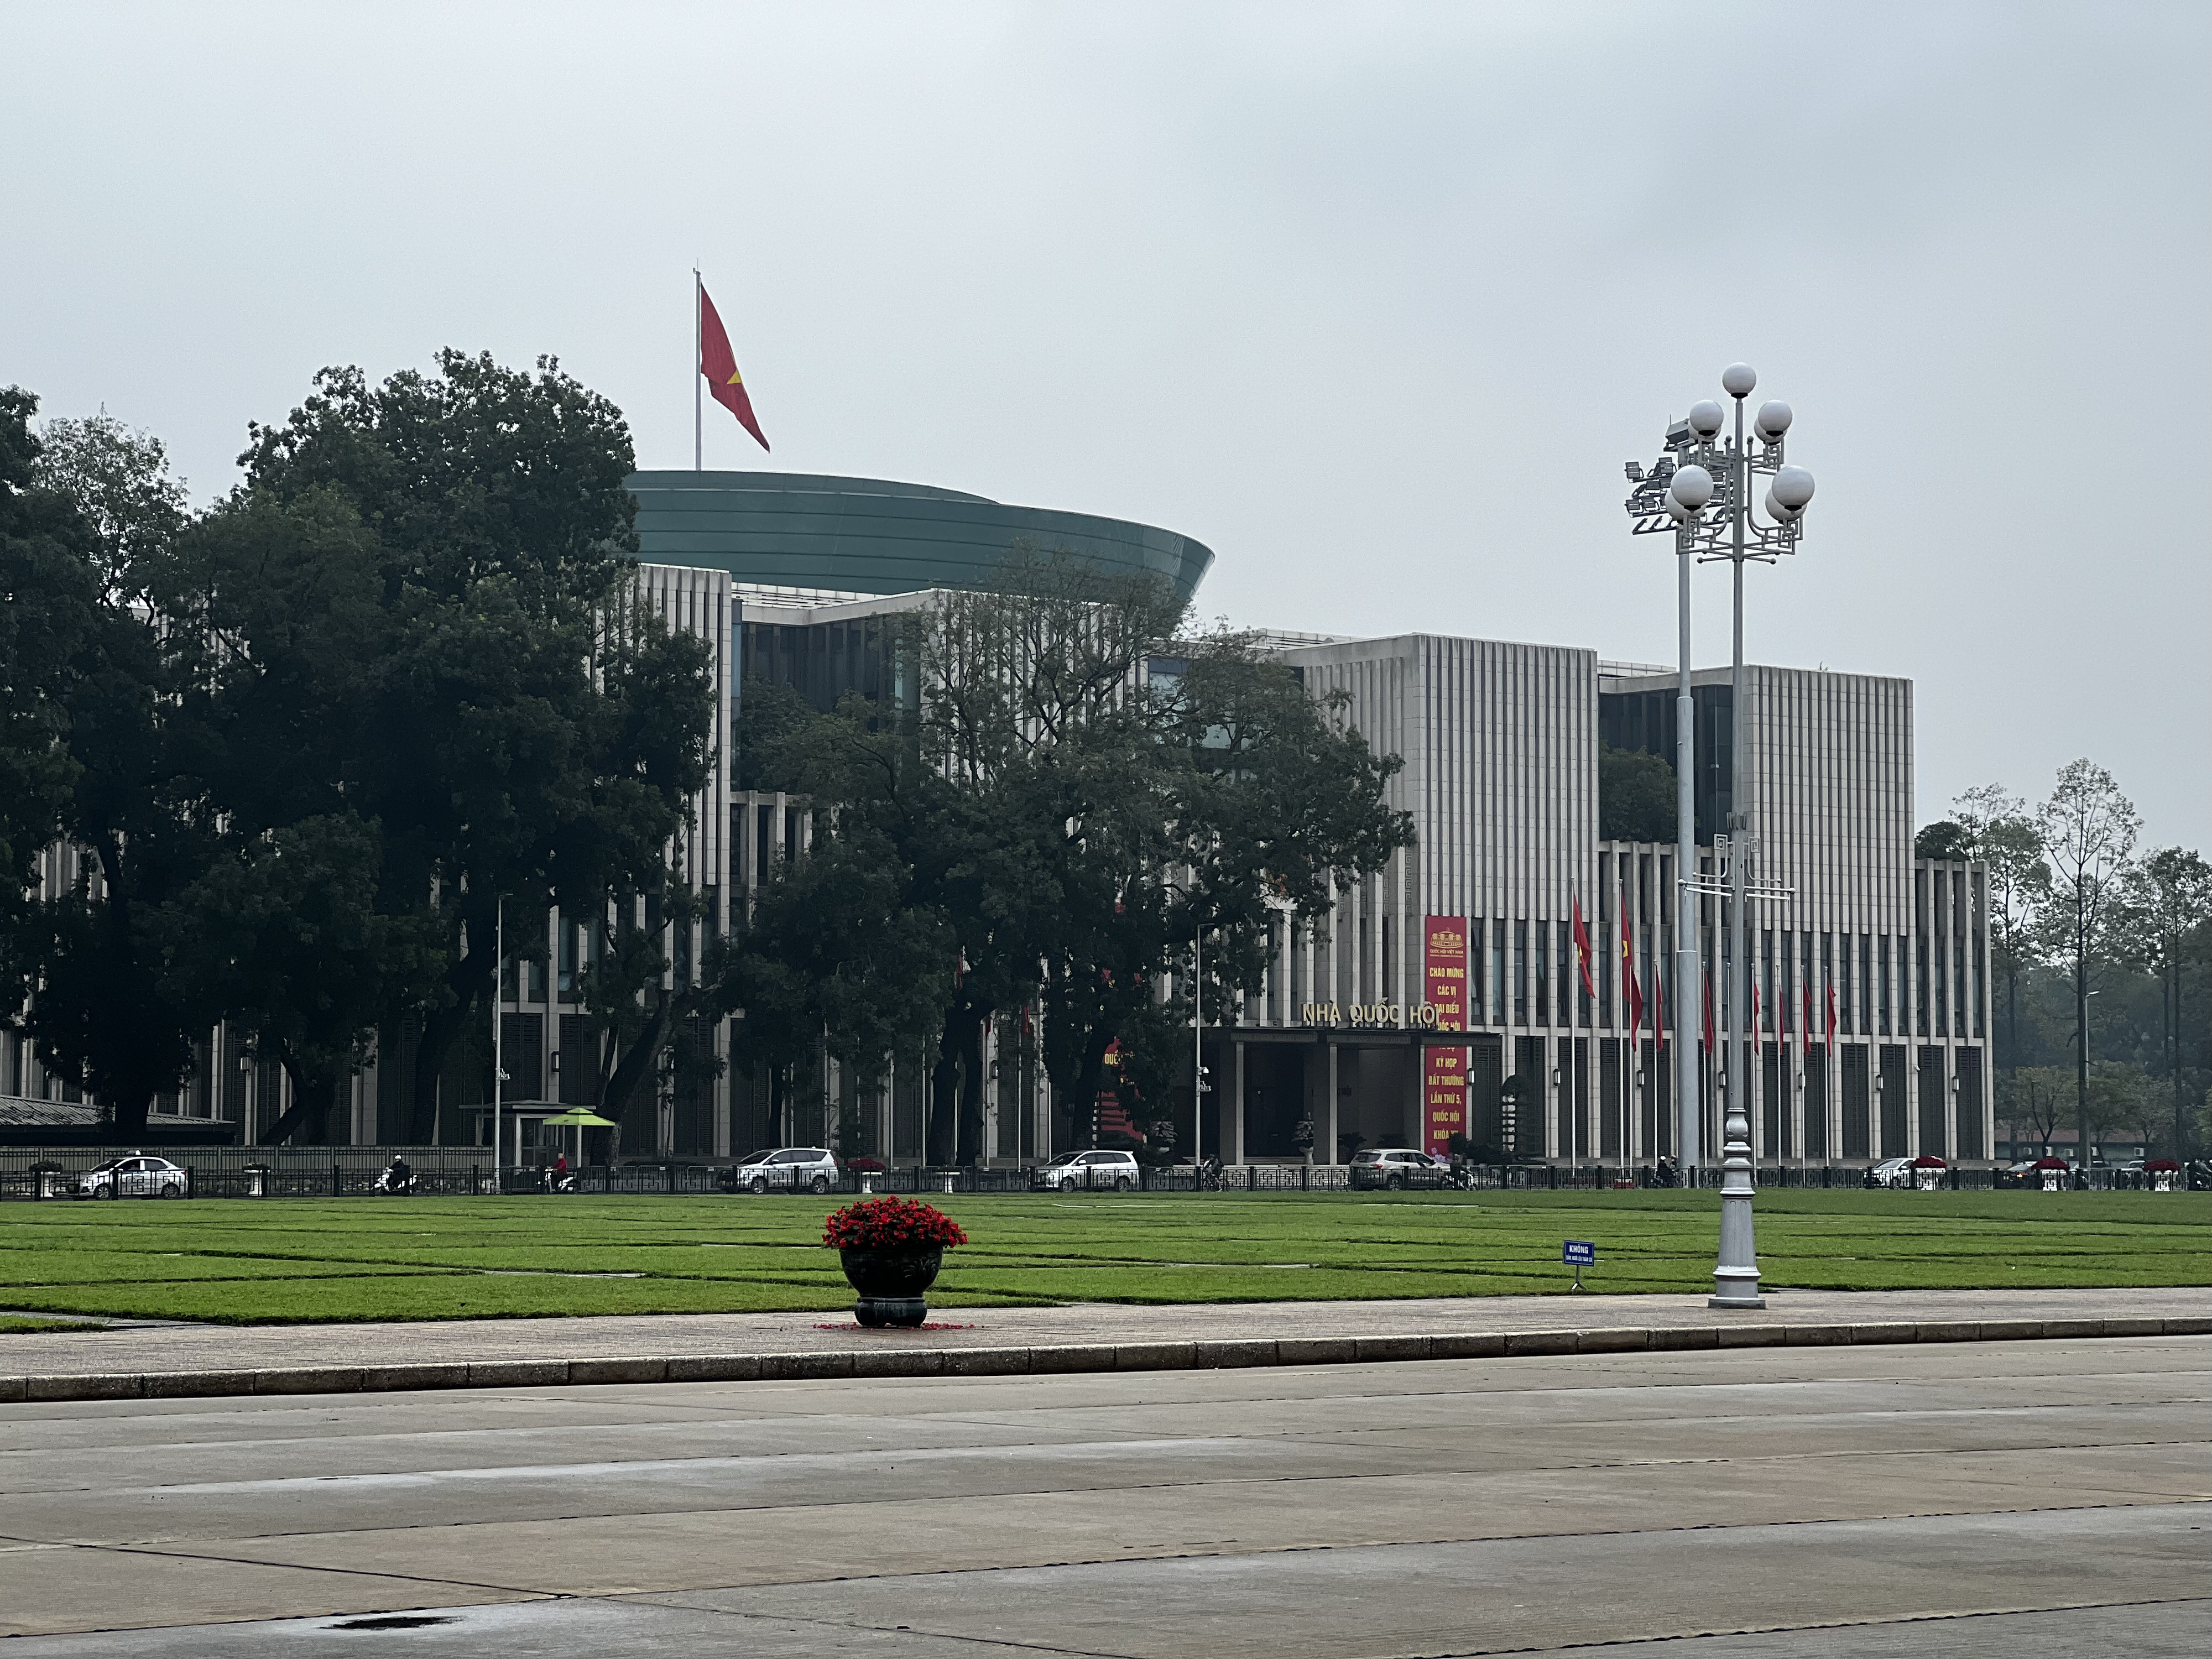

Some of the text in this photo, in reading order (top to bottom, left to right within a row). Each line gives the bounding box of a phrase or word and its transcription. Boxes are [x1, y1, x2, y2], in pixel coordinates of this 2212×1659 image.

[1430, 966, 1464, 978] CHÀO MỪNG
[1438, 984, 1456, 998] CÁC VỊ
[1303, 997, 1439, 1027] NHÀ QUỐC HỘI
[1446, 1000, 1459, 1014] BIỂU
[1437, 1018, 1449, 1031] UỐC
[1446, 1058, 1457, 1070] HỌP
[1428, 1073, 1464, 1086] BẤT THƯỜNG
[1431, 1091, 1462, 1105] LẦN THỨ 5,
[1433, 1109, 1459, 1124] QUỐC HỘI
[1433, 1128, 1449, 1139] KHÓA
[1569, 1244, 1588, 1254] KHÔNG
